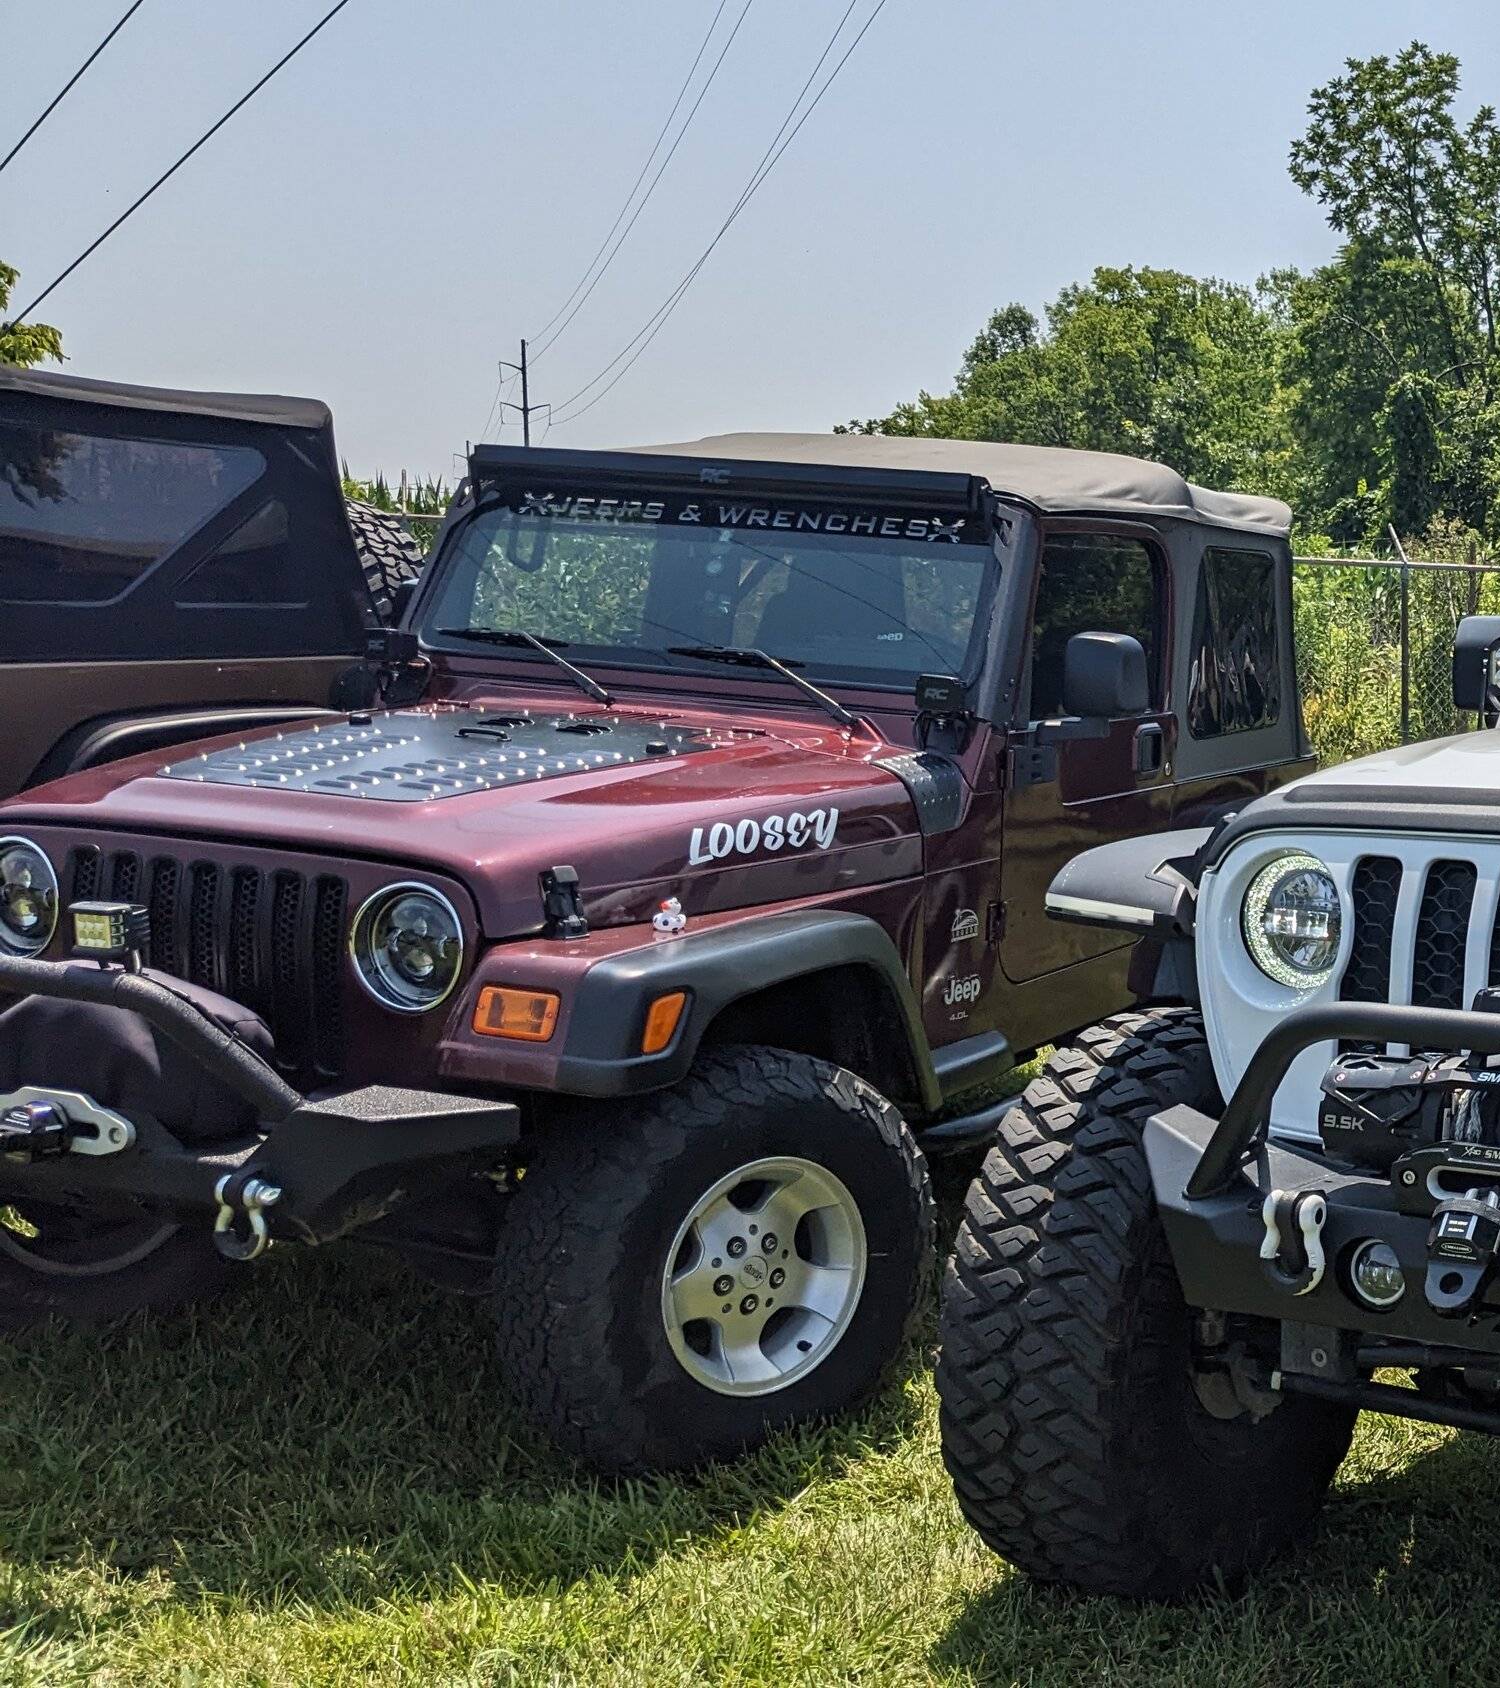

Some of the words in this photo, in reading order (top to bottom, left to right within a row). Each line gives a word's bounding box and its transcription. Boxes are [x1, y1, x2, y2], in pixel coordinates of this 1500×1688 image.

[548, 497, 665, 519] JEEPS
[678, 504, 701, 522] &
[719, 506, 930, 538] WRENCHES
[924, 687, 949, 700] RC
[689, 807, 839, 866] LOOSEY
[944, 978, 981, 1005] Jeep
[1324, 1115, 1365, 1132] 9.5K
